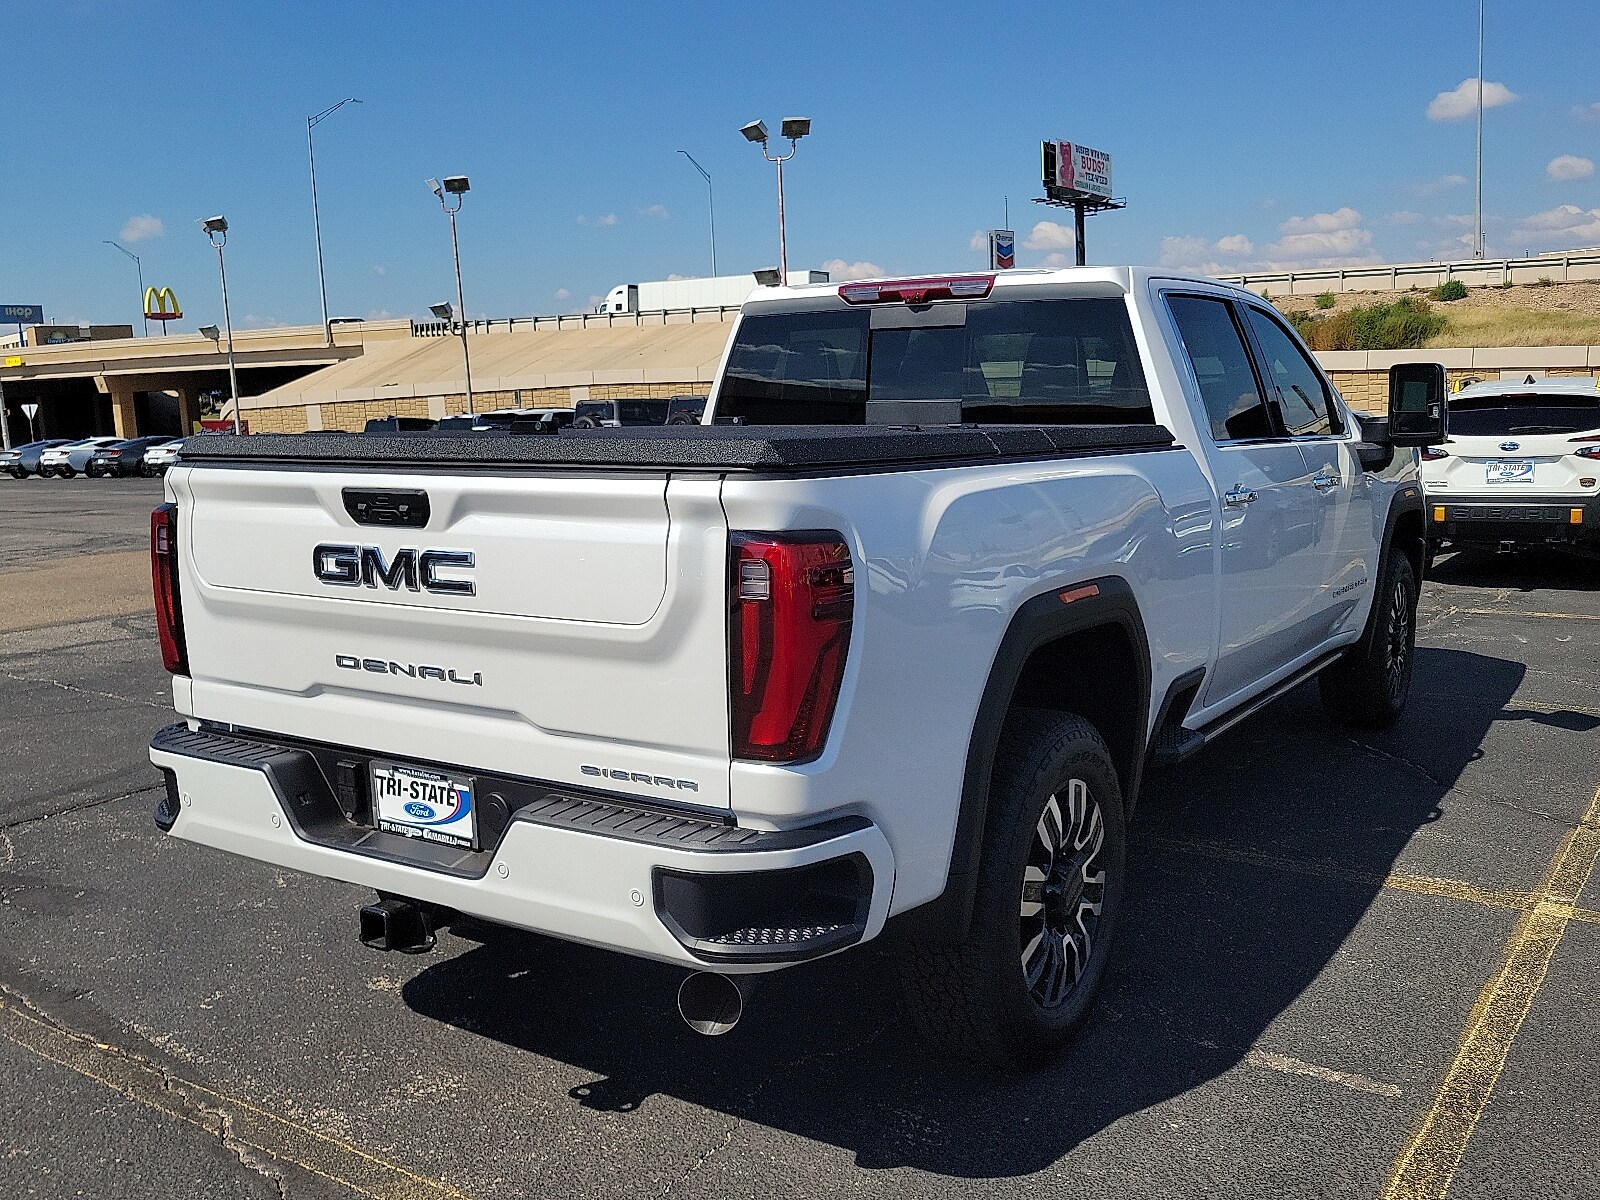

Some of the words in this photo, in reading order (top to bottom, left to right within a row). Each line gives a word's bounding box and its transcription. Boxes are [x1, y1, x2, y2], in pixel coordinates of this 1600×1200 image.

[1081, 155, 1105, 175] BUDS?
[1488, 464, 1526, 473] TRI-STATE
[1452, 508, 1563, 521] SUBARU
[313, 543, 476, 596] GMC
[335, 653, 483, 687] DENALI
[580, 764, 699, 793] SIERRA
[375, 775, 456, 807] TRI-STATE
[409, 803, 430, 817] Ford
